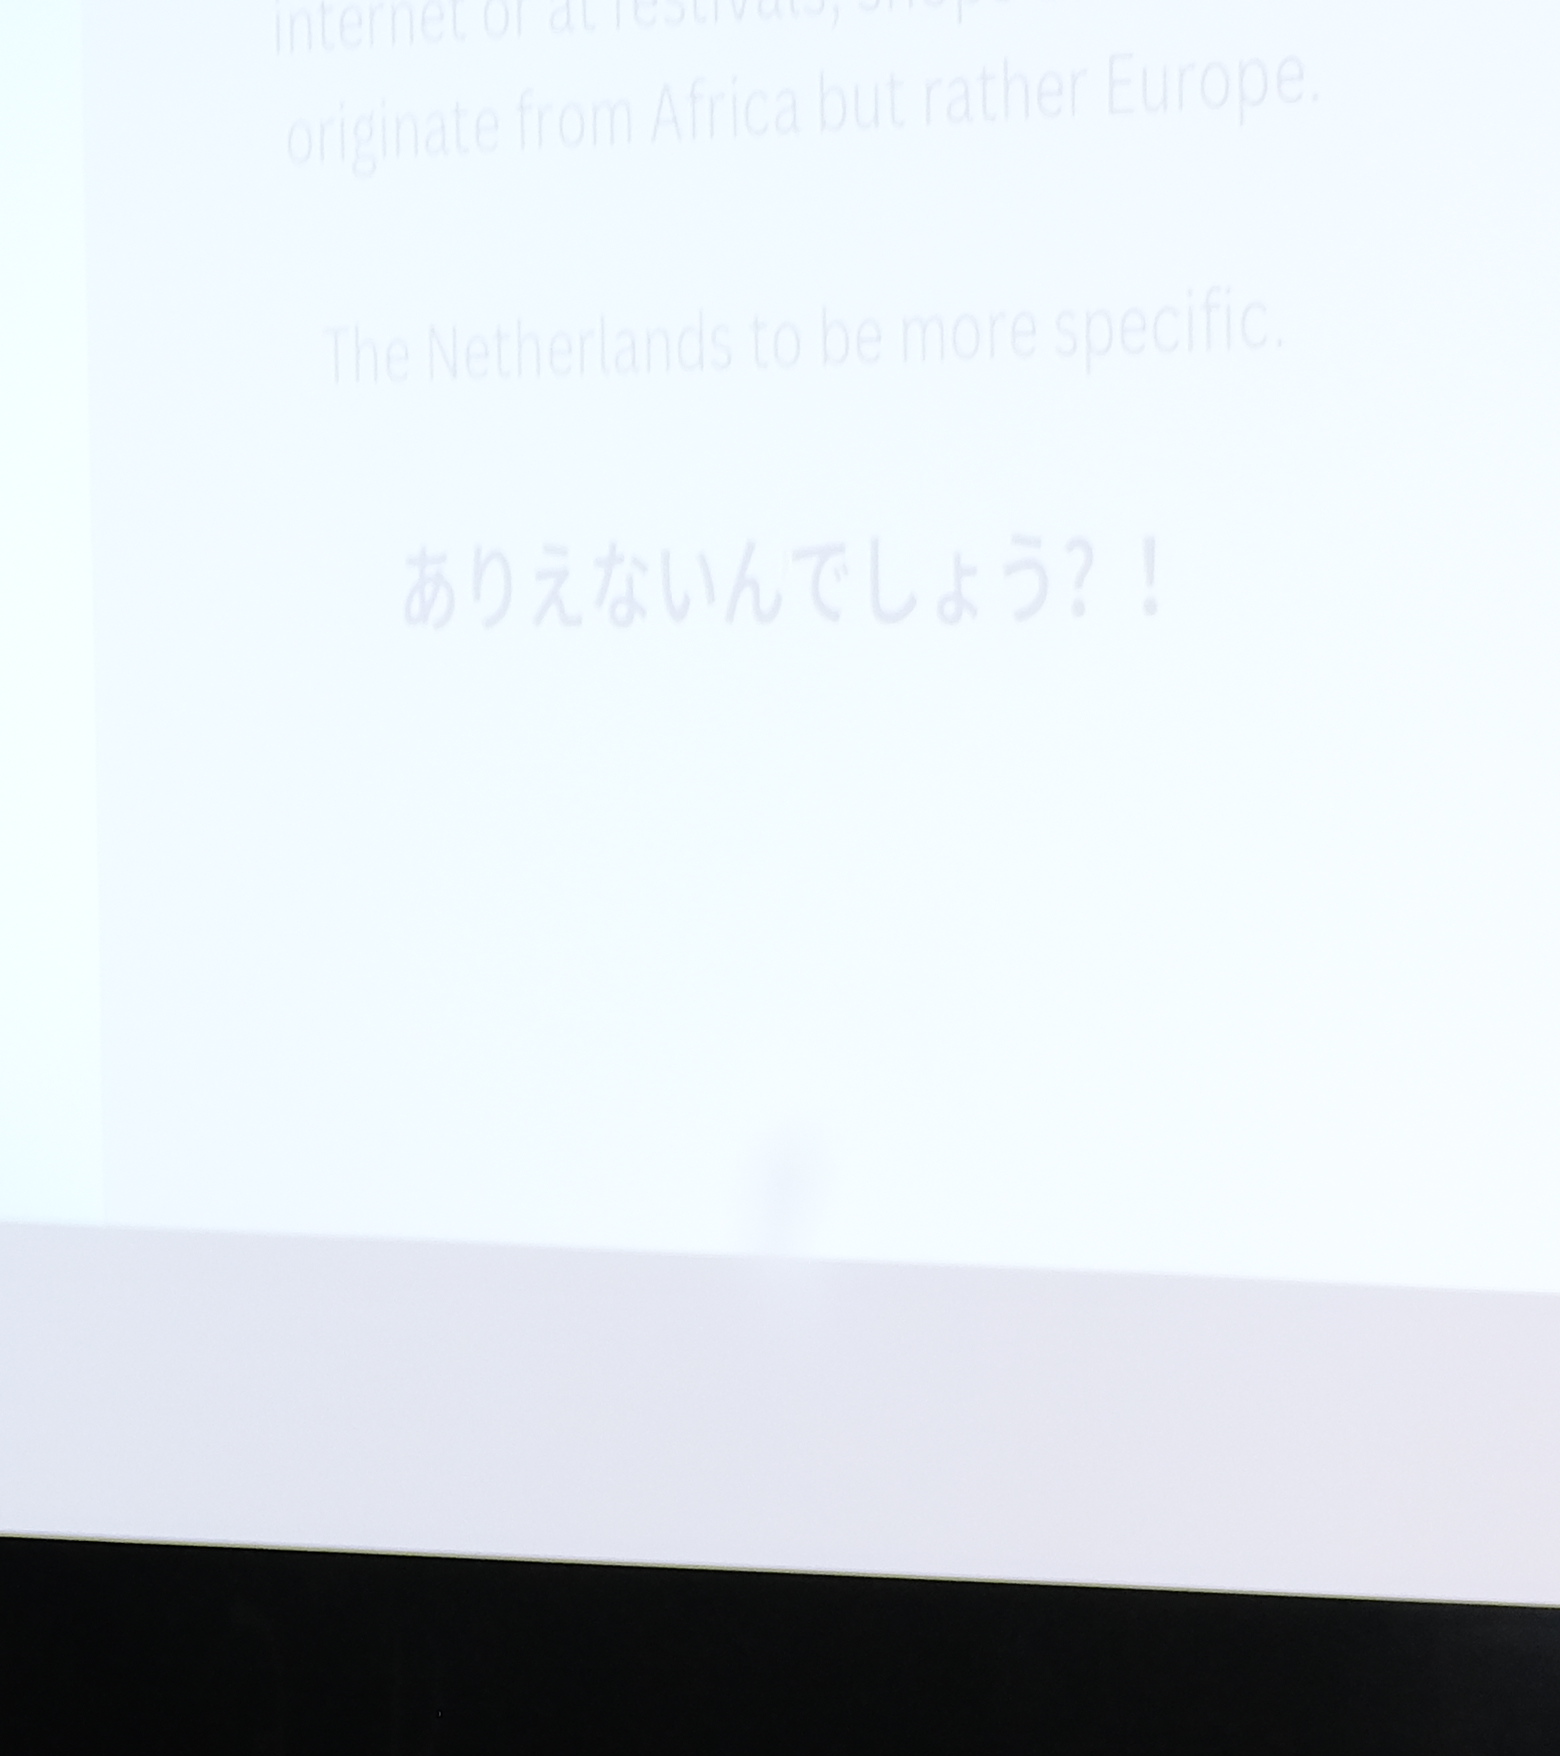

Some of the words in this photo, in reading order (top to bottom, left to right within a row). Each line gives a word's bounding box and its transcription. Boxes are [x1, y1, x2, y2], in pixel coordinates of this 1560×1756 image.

[286, 101, 501, 180] originate
[516, 87, 634, 152] from
[650, 75, 803, 145] Africa
[818, 70, 907, 134] but
[924, 57, 1089, 127] rather
[1107, 52, 1321, 128] Europe.
[324, 323, 412, 386] The
[428, 308, 735, 382] Netherlands
[750, 314, 804, 371] to
[820, 305, 885, 368] be
[901, 311, 1039, 365] more
[1054, 285, 1285, 377] specific.
